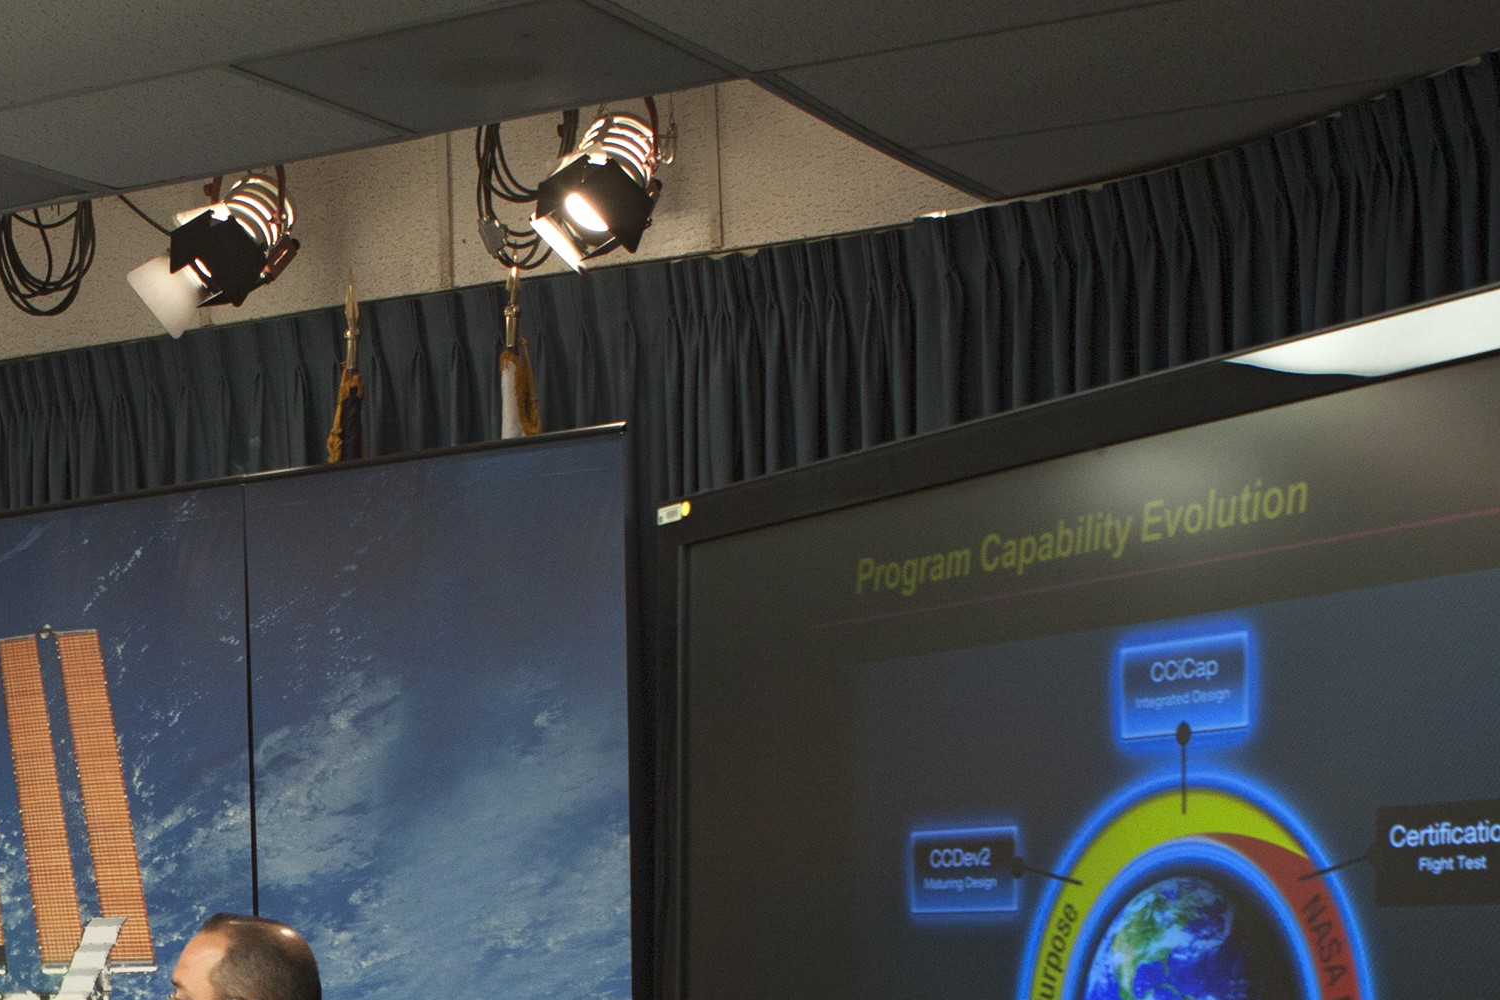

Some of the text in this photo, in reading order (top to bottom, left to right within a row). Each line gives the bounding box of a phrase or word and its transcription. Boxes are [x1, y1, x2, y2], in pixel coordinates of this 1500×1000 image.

[855, 479, 1309, 597] Program Capability Evolution
[929, 847, 991, 868] CCDev2
[1418, 854, 1488, 875] Flight Test
[965, 876, 997, 891] Design
[1302, 893, 1348, 987] NASA
